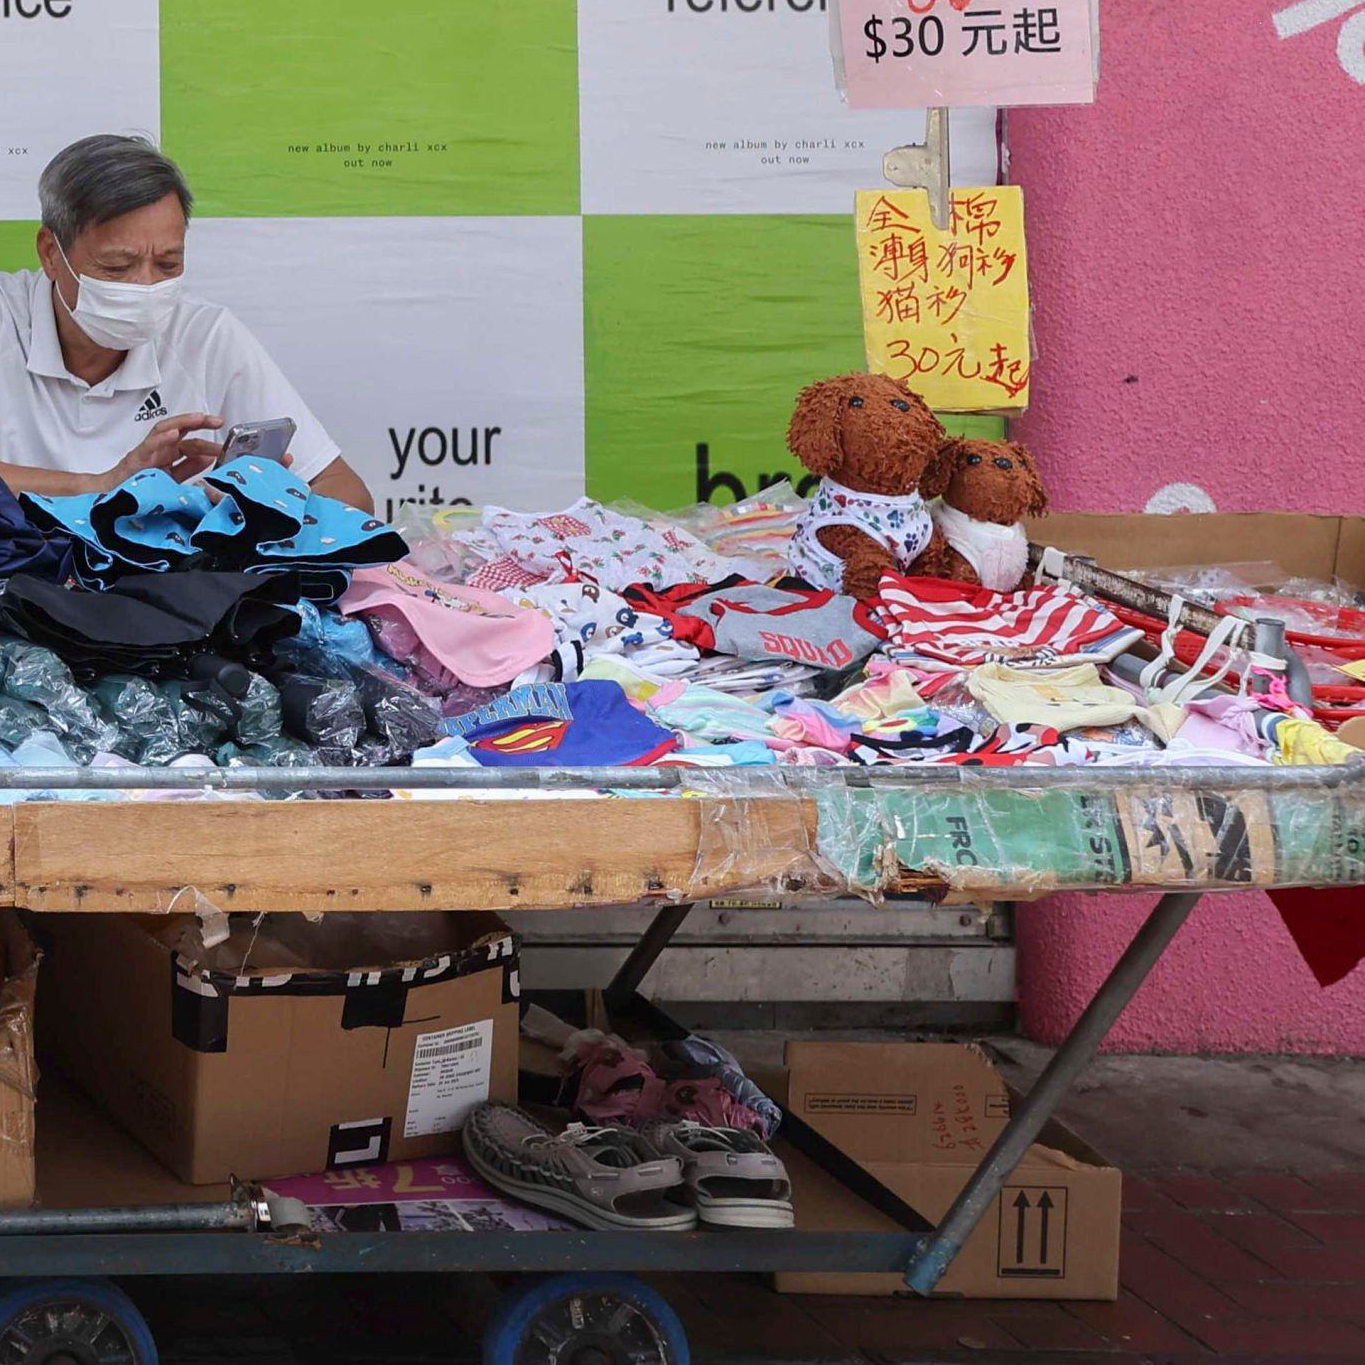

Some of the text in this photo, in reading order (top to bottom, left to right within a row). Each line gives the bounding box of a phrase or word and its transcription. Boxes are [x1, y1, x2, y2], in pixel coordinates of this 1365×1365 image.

[864, 10, 1062, 63] $30 元起
[8, 147, 28, 155] xcx
[759, 631, 855, 670] SQUAD
